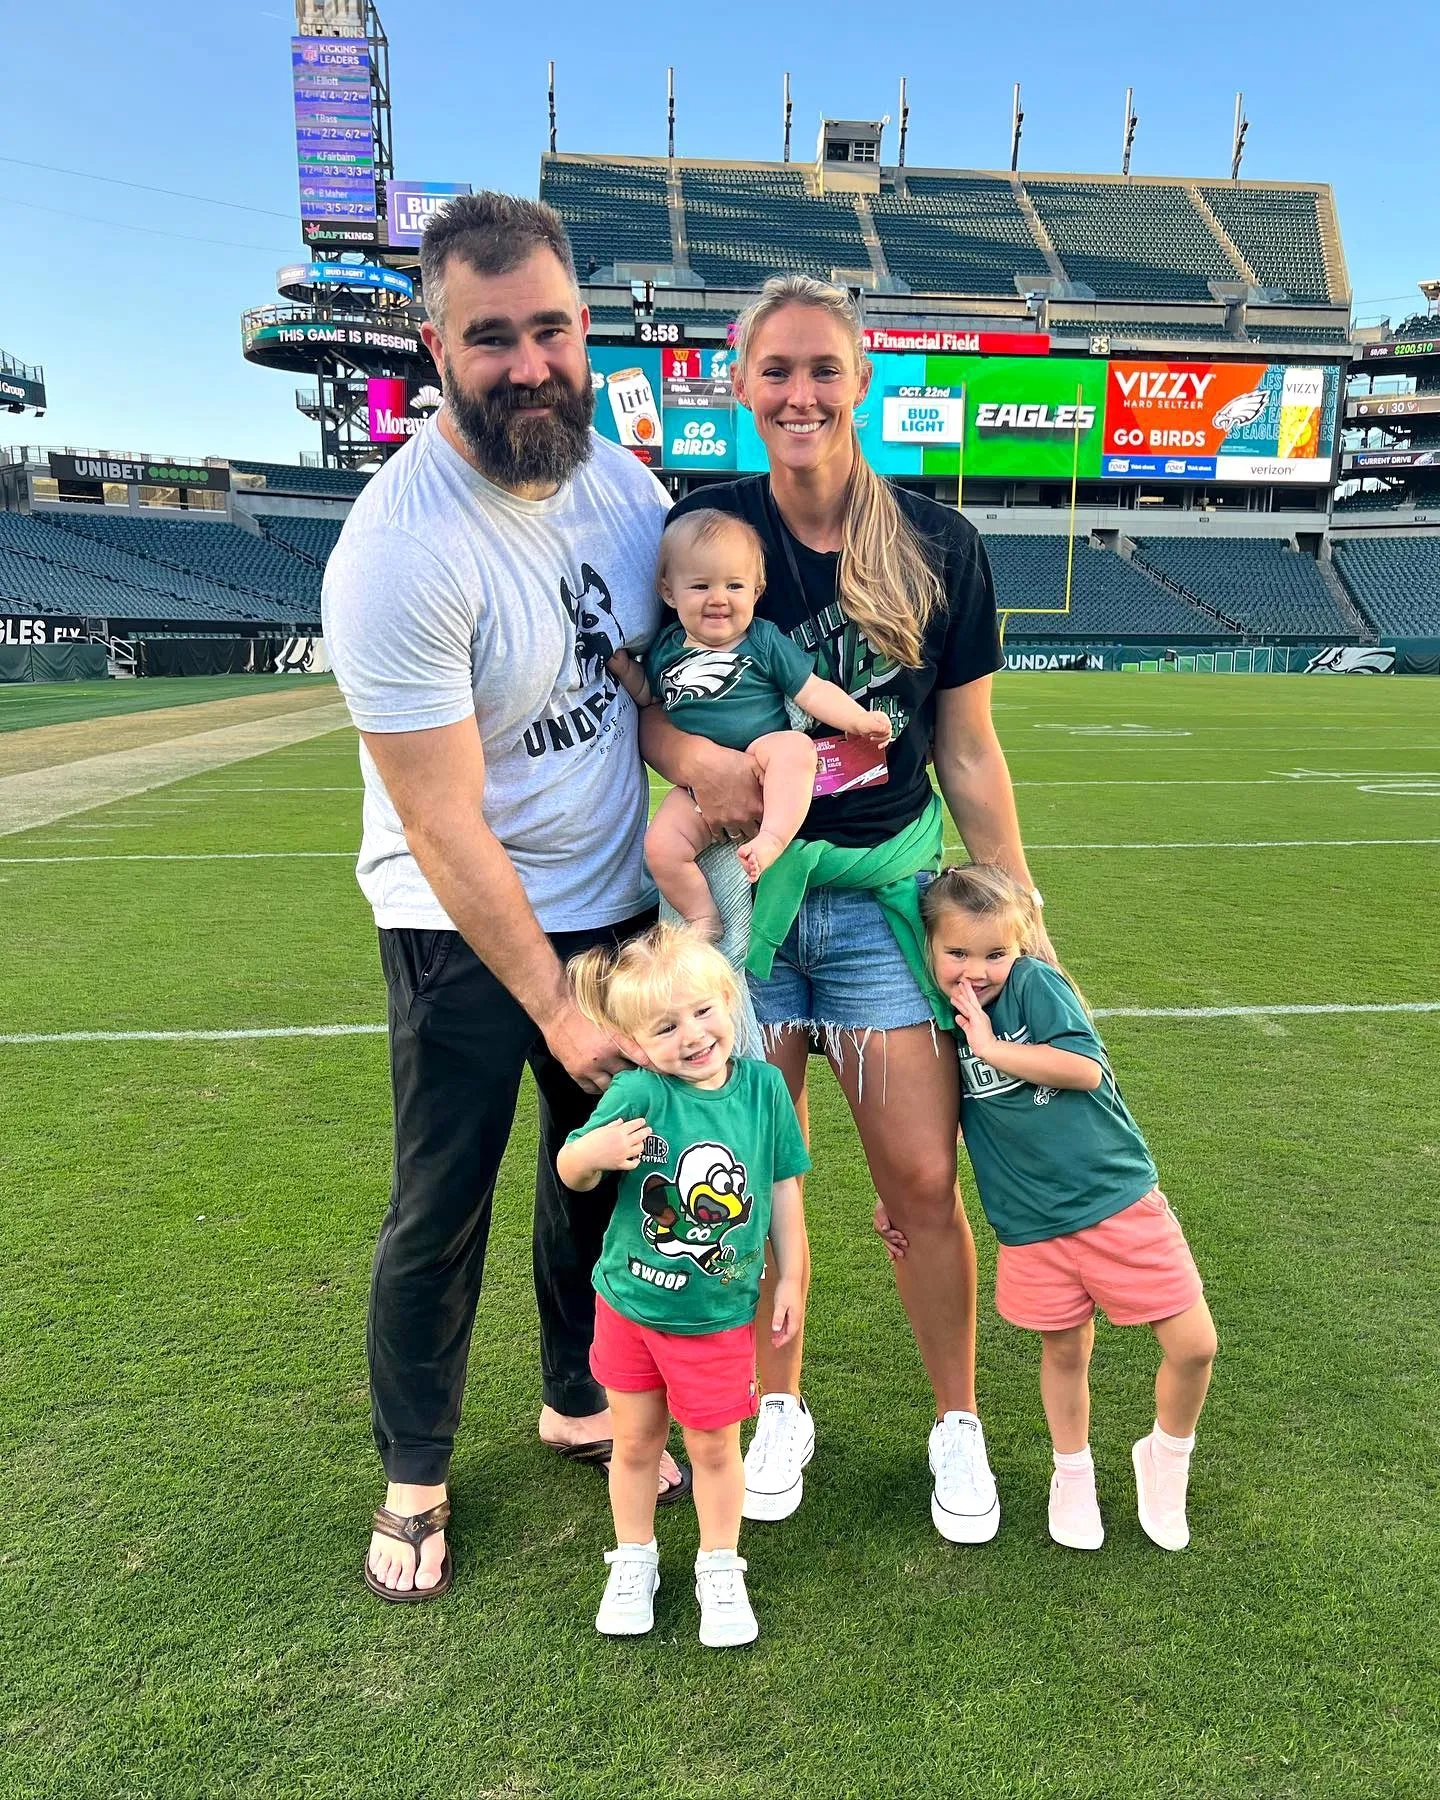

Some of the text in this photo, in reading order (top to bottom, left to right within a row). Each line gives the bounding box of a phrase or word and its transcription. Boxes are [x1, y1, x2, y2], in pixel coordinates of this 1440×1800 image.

[319, 44, 357, 54] KICKING
[319, 55, 360, 65] LEADERS
[343, 91, 358, 101] 2/2
[322, 128, 337, 138] 2/2
[349, 203, 364, 213] 2/2
[308, 230, 375, 241] DRAFTKINGS
[278, 329, 305, 343] THIS
[307, 328, 346, 343] GAME
[349, 330, 361, 344] IS
[640, 323, 679, 343] 3:58
[873, 331, 940, 350] Financial
[942, 333, 980, 351] Field
[1394, 342, 1433, 356] $200,510
[672, 361, 728, 378] 31 34
[2, 382, 25, 398] Group
[1114, 371, 1211, 400] VIZZY
[1286, 383, 1319, 394] VIZZY
[899, 387, 951, 398] OCT. 22nd
[1123, 400, 1204, 410] HARD SELTZER
[1391, 402, 1404, 413] 30
[908, 408, 939, 420] BUD
[975, 403, 1097, 429] EAGLES
[683, 421, 716, 439] GO
[901, 420, 944, 432] LIGHT
[1113, 429, 1144, 446] GO
[1150, 430, 1206, 448] BIRDS
[672, 438, 728, 456] BIRDS
[1359, 454, 1412, 466] CURRENT DRIVE
[74, 459, 145, 481] UNIBET
[1250, 463, 1292, 476] verizon
[1007, 654, 1104, 670] UNDATIN
[631, 1262, 687, 1291] SWOOP
